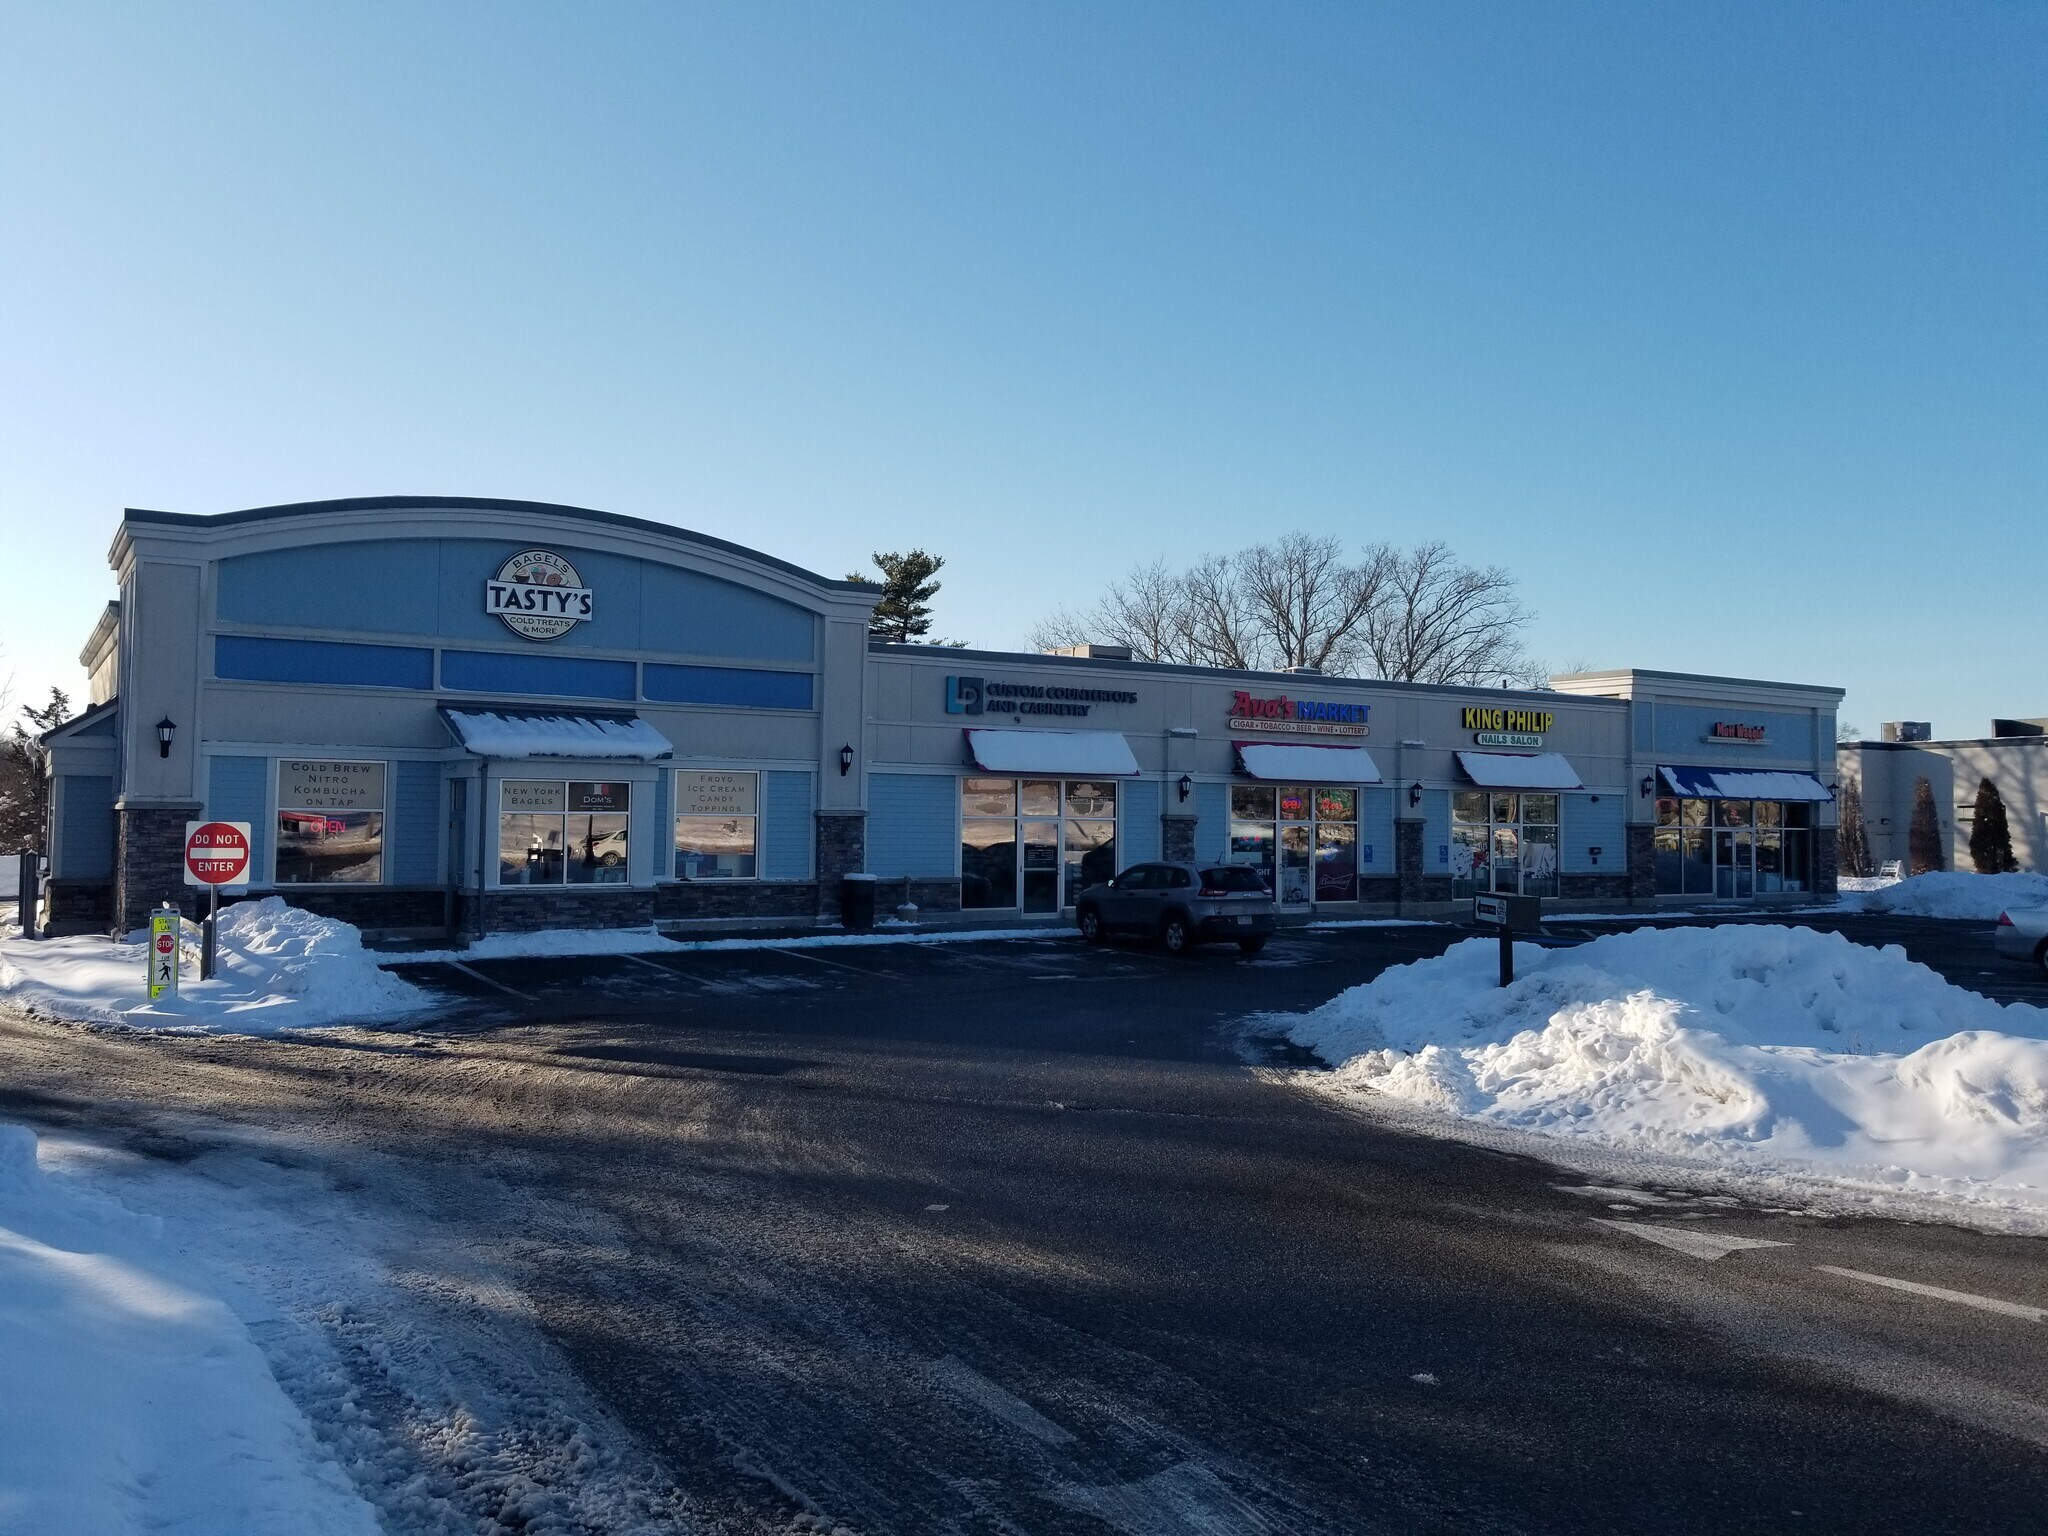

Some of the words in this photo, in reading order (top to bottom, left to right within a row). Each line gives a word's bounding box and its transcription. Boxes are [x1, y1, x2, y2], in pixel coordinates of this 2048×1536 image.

[513, 553, 570, 574] BAGELS
[489, 586, 592, 615] TASTY'S
[509, 617, 535, 625] COLD
[536, 619, 571, 628] TREATS
[986, 683, 1044, 699] CUSTOM
[1046, 686, 1138, 704] COUNTERTOPS
[986, 700, 1018, 714] AND
[1019, 701, 1091, 717] CABINETRY
[1229, 690, 1295, 719] Ava's
[1297, 700, 1371, 723] MARKET
[1463, 708, 1502, 730] KING
[1505, 710, 1553, 733] PHILIP
[1233, 720, 1255, 729] CIGAR
[1260, 722, 1291, 731] TOBACCO
[1339, 727, 1365, 735] LOTTERY
[1481, 735, 1508, 744] NAILS
[1510, 736, 1539, 746] SALON
[291, 763, 327, 772] COLD
[333, 764, 371, 773] BREW
[309, 775, 348, 784] NITRO
[700, 775, 733, 783] FROYO
[294, 786, 366, 796] KOMBUCHA
[504, 787, 528, 795] NEW
[533, 788, 561, 796] YORK
[710, 785, 745, 793] CREAM
[330, 798, 354, 806] TAP
[511, 797, 554, 805] BAGELS
[583, 796, 612, 804] DOM'S
[699, 795, 734, 803] CANDY
[310, 820, 346, 833] OPEN
[195, 834, 210, 845] DO
[216, 834, 240, 845] NOT
[198, 862, 234, 872] ENTER
[157, 940, 174, 949] STOP
